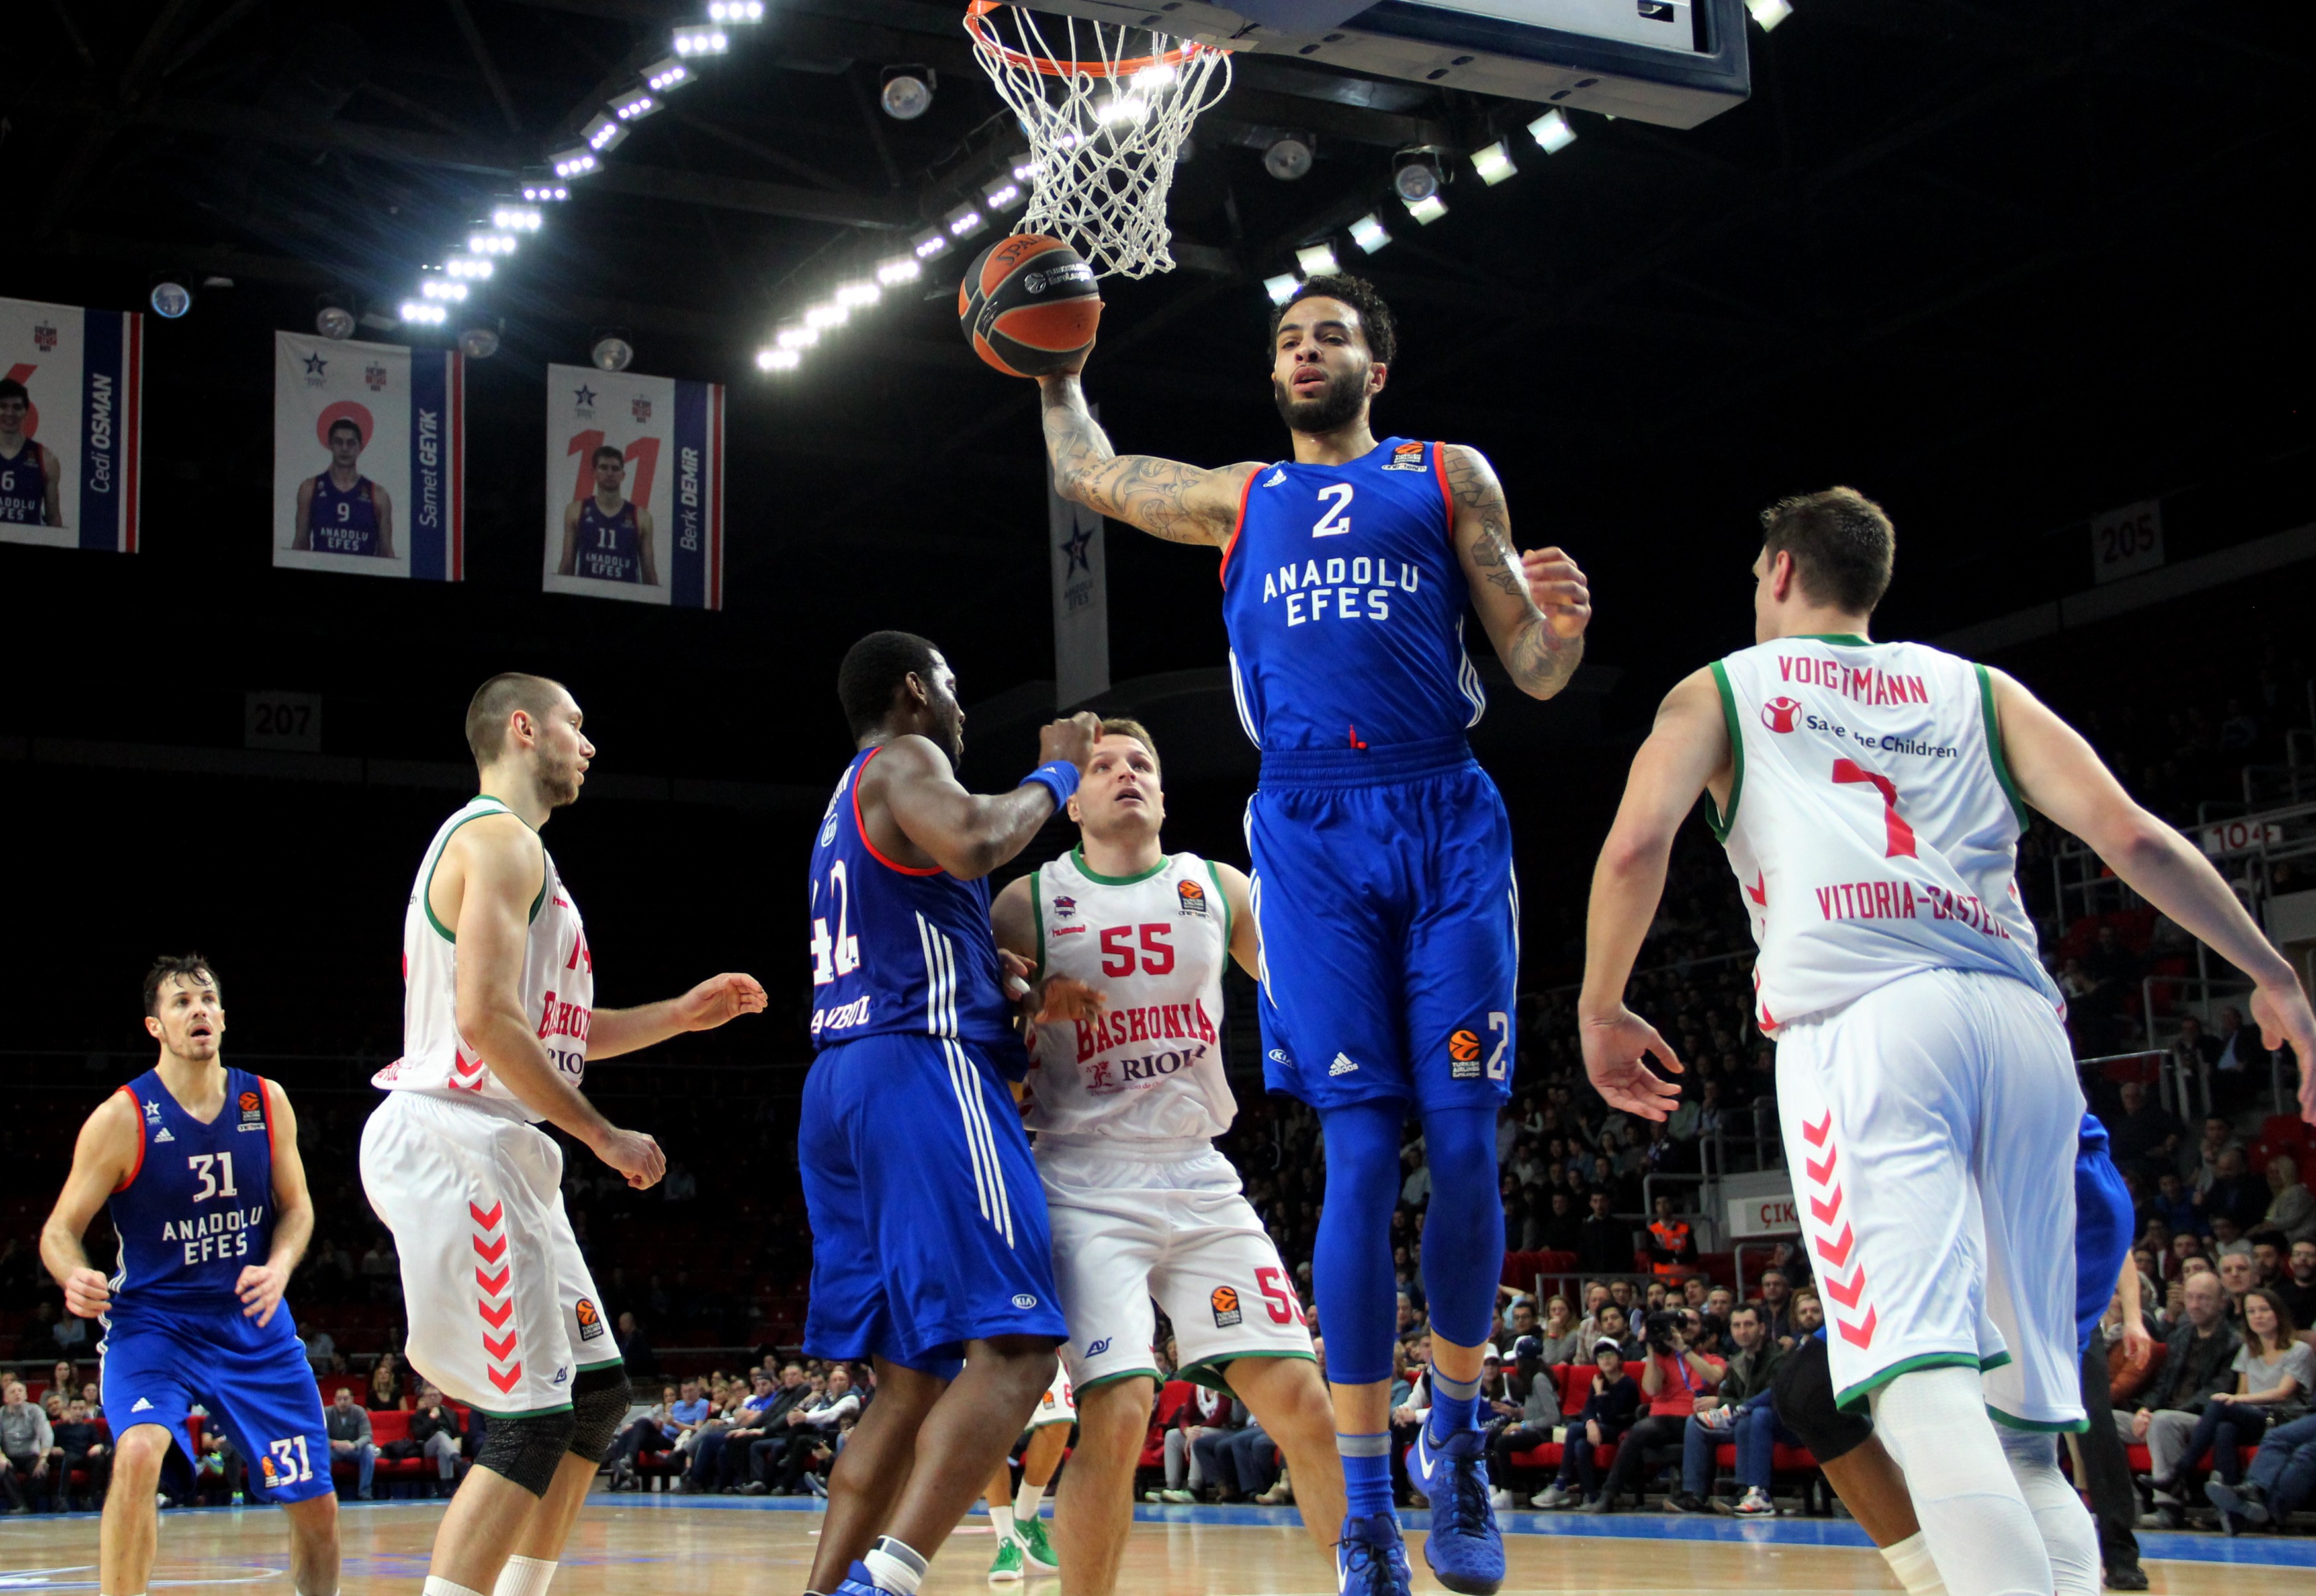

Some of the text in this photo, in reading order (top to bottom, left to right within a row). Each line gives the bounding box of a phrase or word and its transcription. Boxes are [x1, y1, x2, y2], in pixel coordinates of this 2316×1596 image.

[90, 373, 112, 493] Cedi OSMAN
[1, 470, 15, 491] 6
[419, 468, 437, 528] Samet
[337, 502, 350, 522] 9
[680, 509, 697, 552] Berk
[1312, 482, 1354, 538] 2
[320, 527, 369, 541] ANADOLU
[328, 537, 359, 551] EFES
[597, 527, 617, 550] 11
[2102, 515, 2154, 564] 205
[592, 562, 622, 578] EFES
[1263, 556, 1418, 603] ANADOLU
[1286, 587, 1389, 627] EFES
[1778, 655, 1929, 705] VOIGTMANN
[256, 703, 310, 736] 207
[1806, 715, 1957, 758] Sae he Children
[1832, 758, 1919, 860] 7
[811, 860, 860, 985] 42
[1100, 923, 1175, 978] 55
[1073, 998, 1217, 1064] BASKONIA
[1487, 1012, 1509, 1081] 2
[1329, 1063, 1358, 1077] adidas
[188, 1151, 238, 1203] 31
[162, 1206, 263, 1241] ANADOLU
[1761, 1202, 1797, 1229] ÇIK
[185, 1232, 247, 1265] EFES
[270, 1435, 313, 1486] 31
